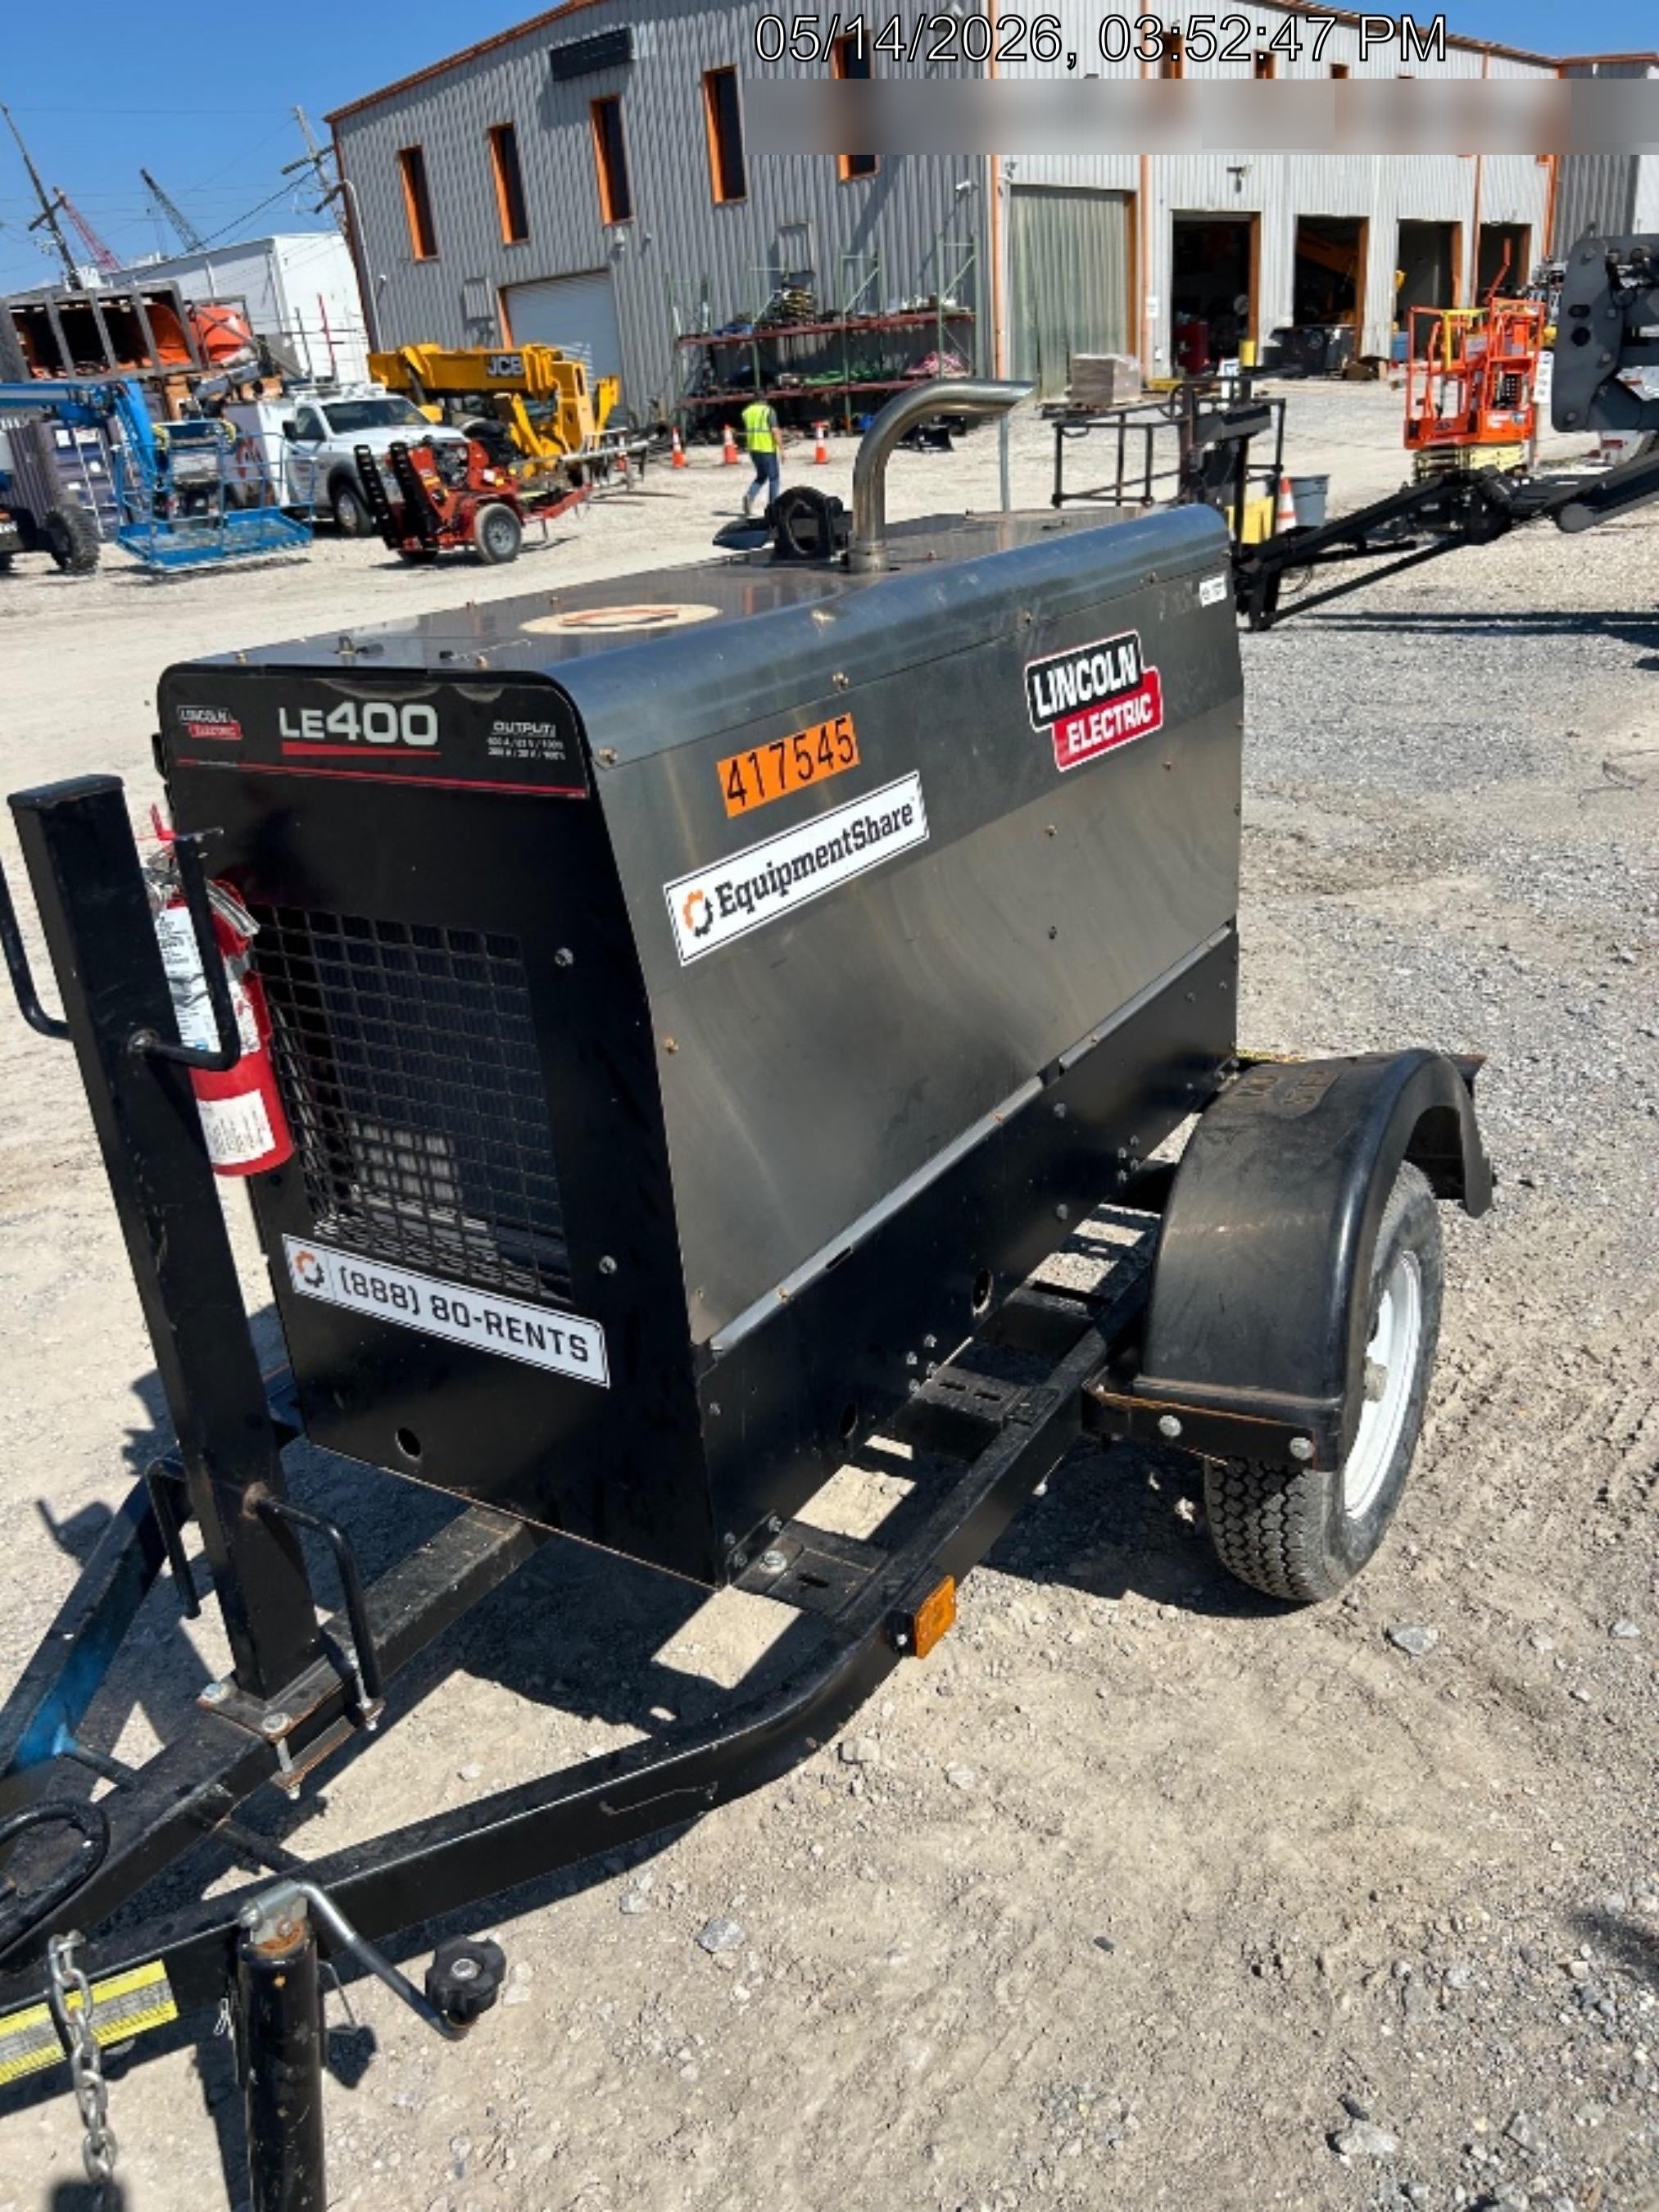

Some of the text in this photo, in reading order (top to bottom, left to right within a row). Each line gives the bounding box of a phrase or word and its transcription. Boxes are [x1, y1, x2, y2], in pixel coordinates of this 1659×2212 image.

[487, 356, 524, 376] JCB
[1032, 643, 1139, 718] LINCOLN
[279, 700, 439, 746] LE400
[1066, 692, 1154, 755] ELECTRIC
[727, 717, 854, 807] 417545
[714, 801, 914, 918] EquipmentShare
[338, 1264, 590, 1362] (888) 80-RENTS
